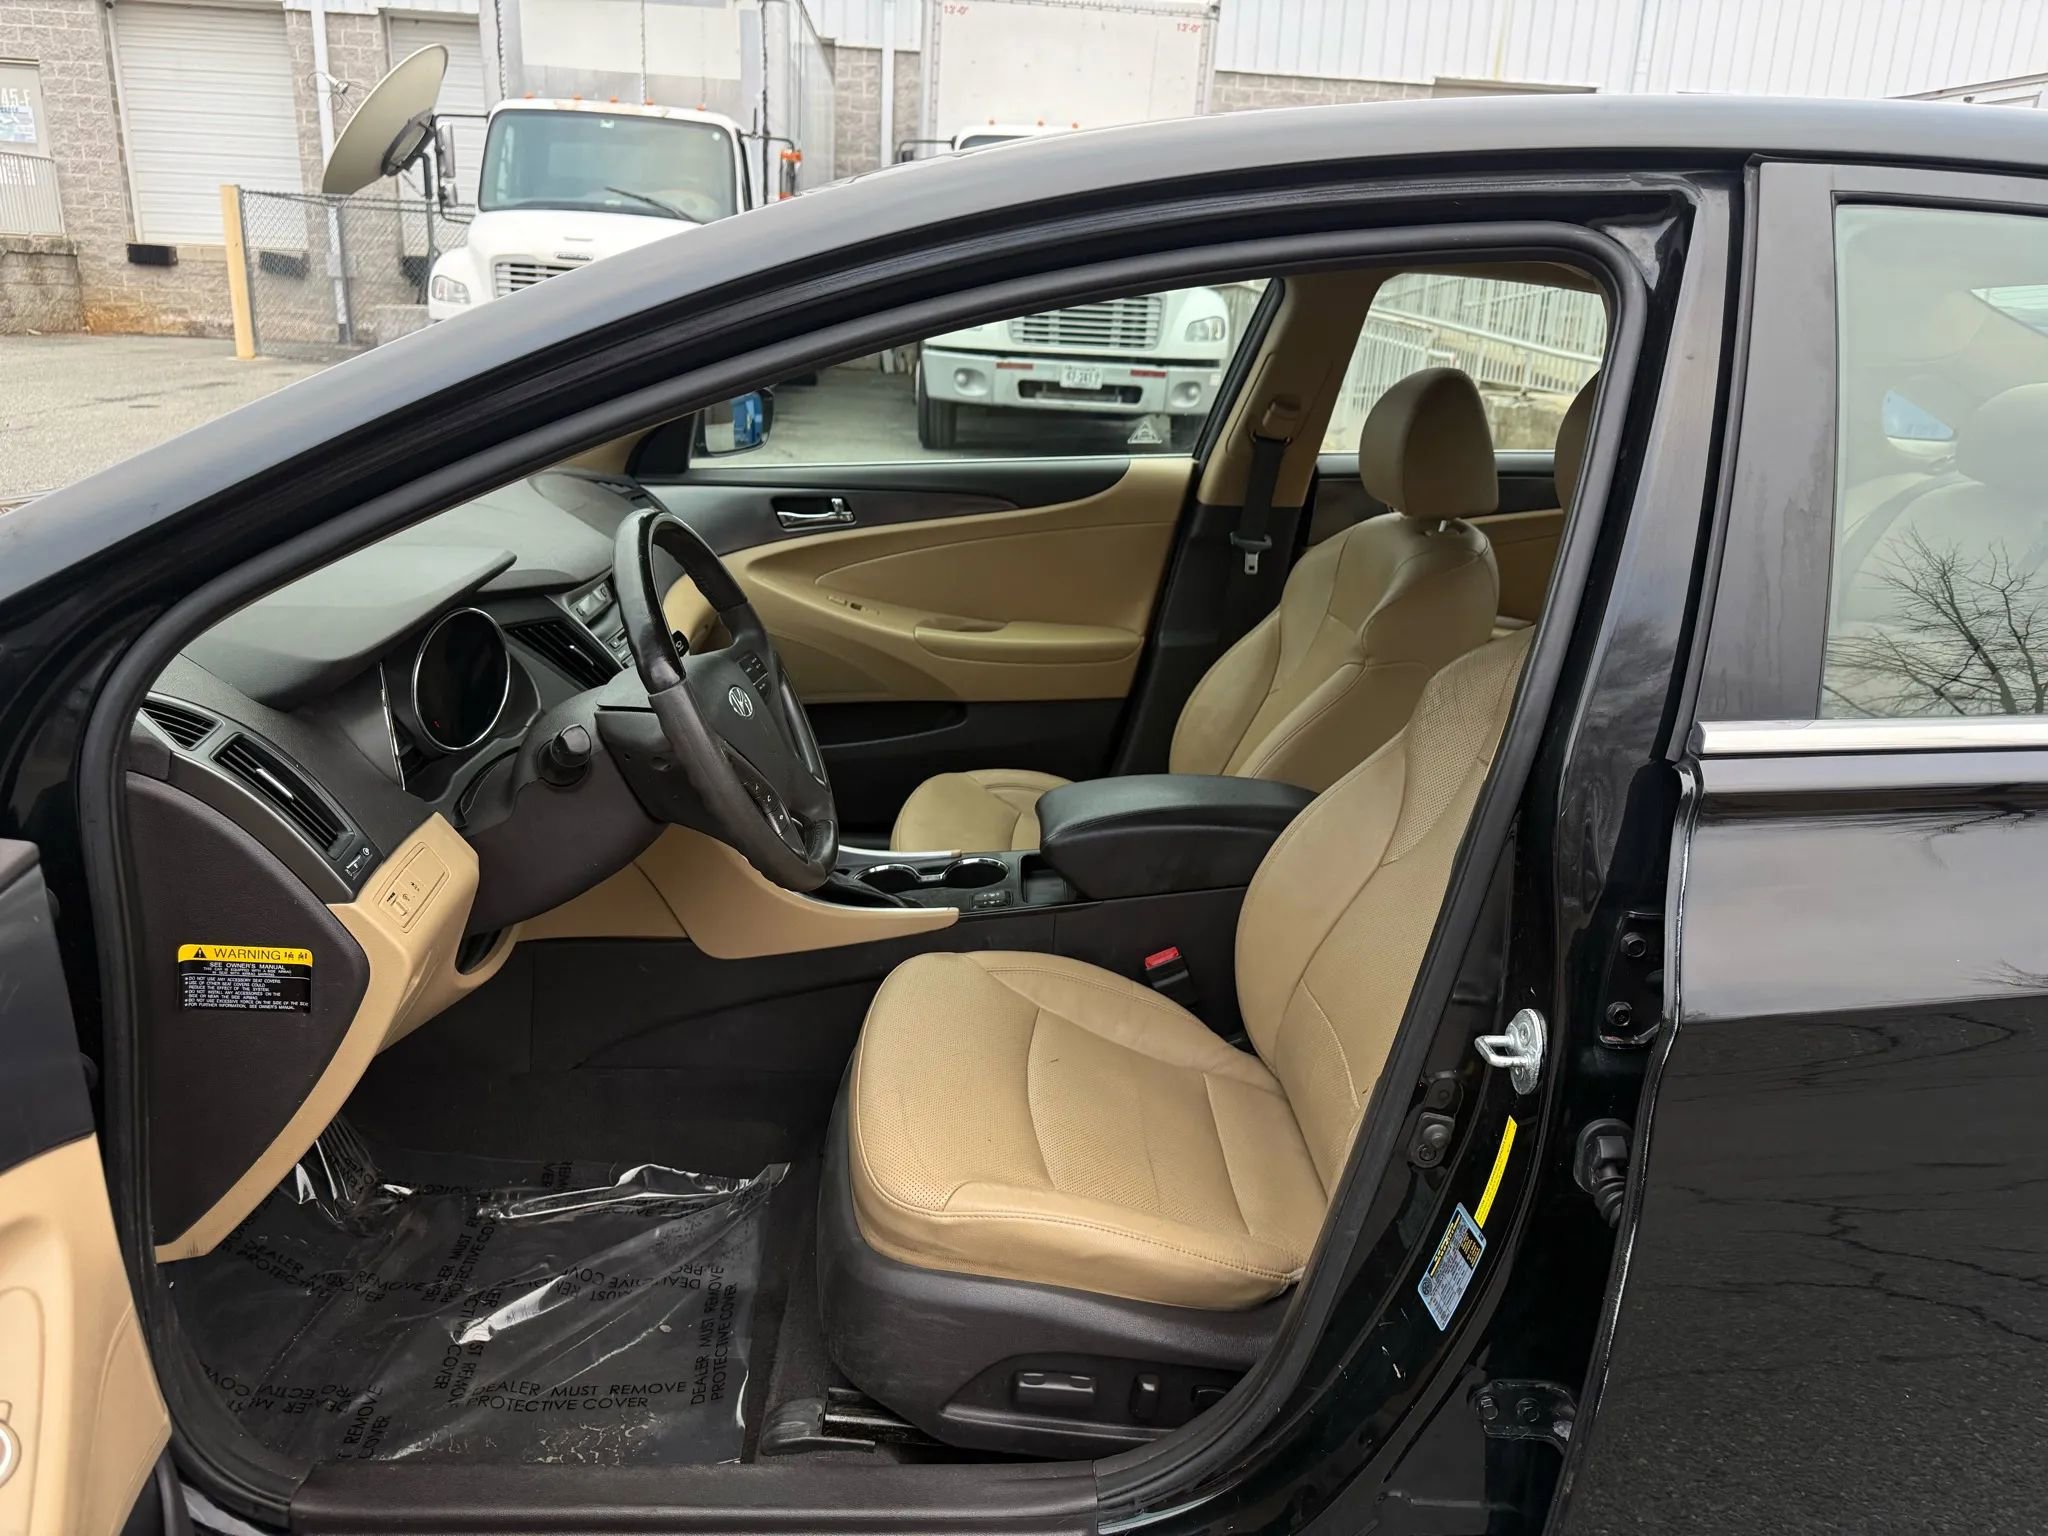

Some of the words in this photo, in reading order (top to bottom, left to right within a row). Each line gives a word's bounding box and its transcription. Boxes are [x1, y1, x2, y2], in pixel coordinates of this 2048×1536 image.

[214, 948, 281, 961] WARNING
[477, 1217, 497, 1243] COV
[244, 1240, 304, 1274] DEALER
[449, 1233, 472, 1260] MUST
[560, 1266, 605, 1286] COV
[432, 1344, 462, 1389] COVER
[691, 1355, 709, 1405] DEALER
[700, 1318, 714, 1348] MUST
[200, 1361, 250, 1397] COV
[471, 1381, 540, 1396] DEALER
[551, 1385, 599, 1397] MUST
[609, 1381, 686, 1395] REMOVE
[343, 1385, 383, 1445] REMOVE
[466, 1395, 577, 1412] PROTECTIVE
[583, 1397, 649, 1410] COVER
[359, 1415, 391, 1459] COVER
